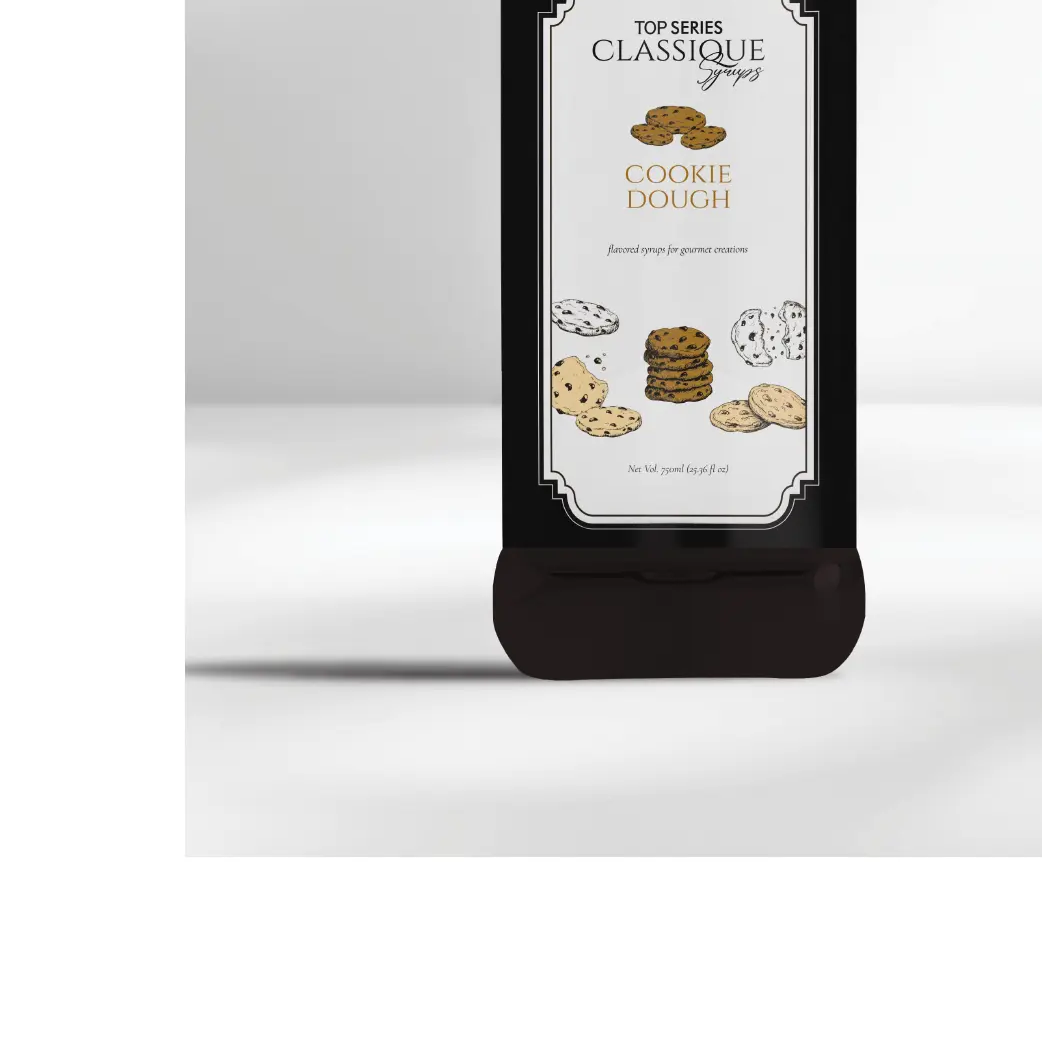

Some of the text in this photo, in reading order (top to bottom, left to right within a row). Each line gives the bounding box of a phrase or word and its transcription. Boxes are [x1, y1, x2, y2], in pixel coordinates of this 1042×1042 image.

[634, 20, 723, 35] TOP SERIES
[592, 39, 766, 68] CLASSIQUE
[697, 51, 765, 91] Syrups
[625, 164, 732, 184] COOKIE
[627, 189, 731, 209] DOUGH
[607, 244, 749, 257] flavored syrups for gourmet creations
[627, 464, 642, 473] Net
[644, 463, 659, 473] Vol.
[660, 464, 685, 476] 750ml
[708, 463, 716, 476] fl
[717, 464, 729, 475] oz)
